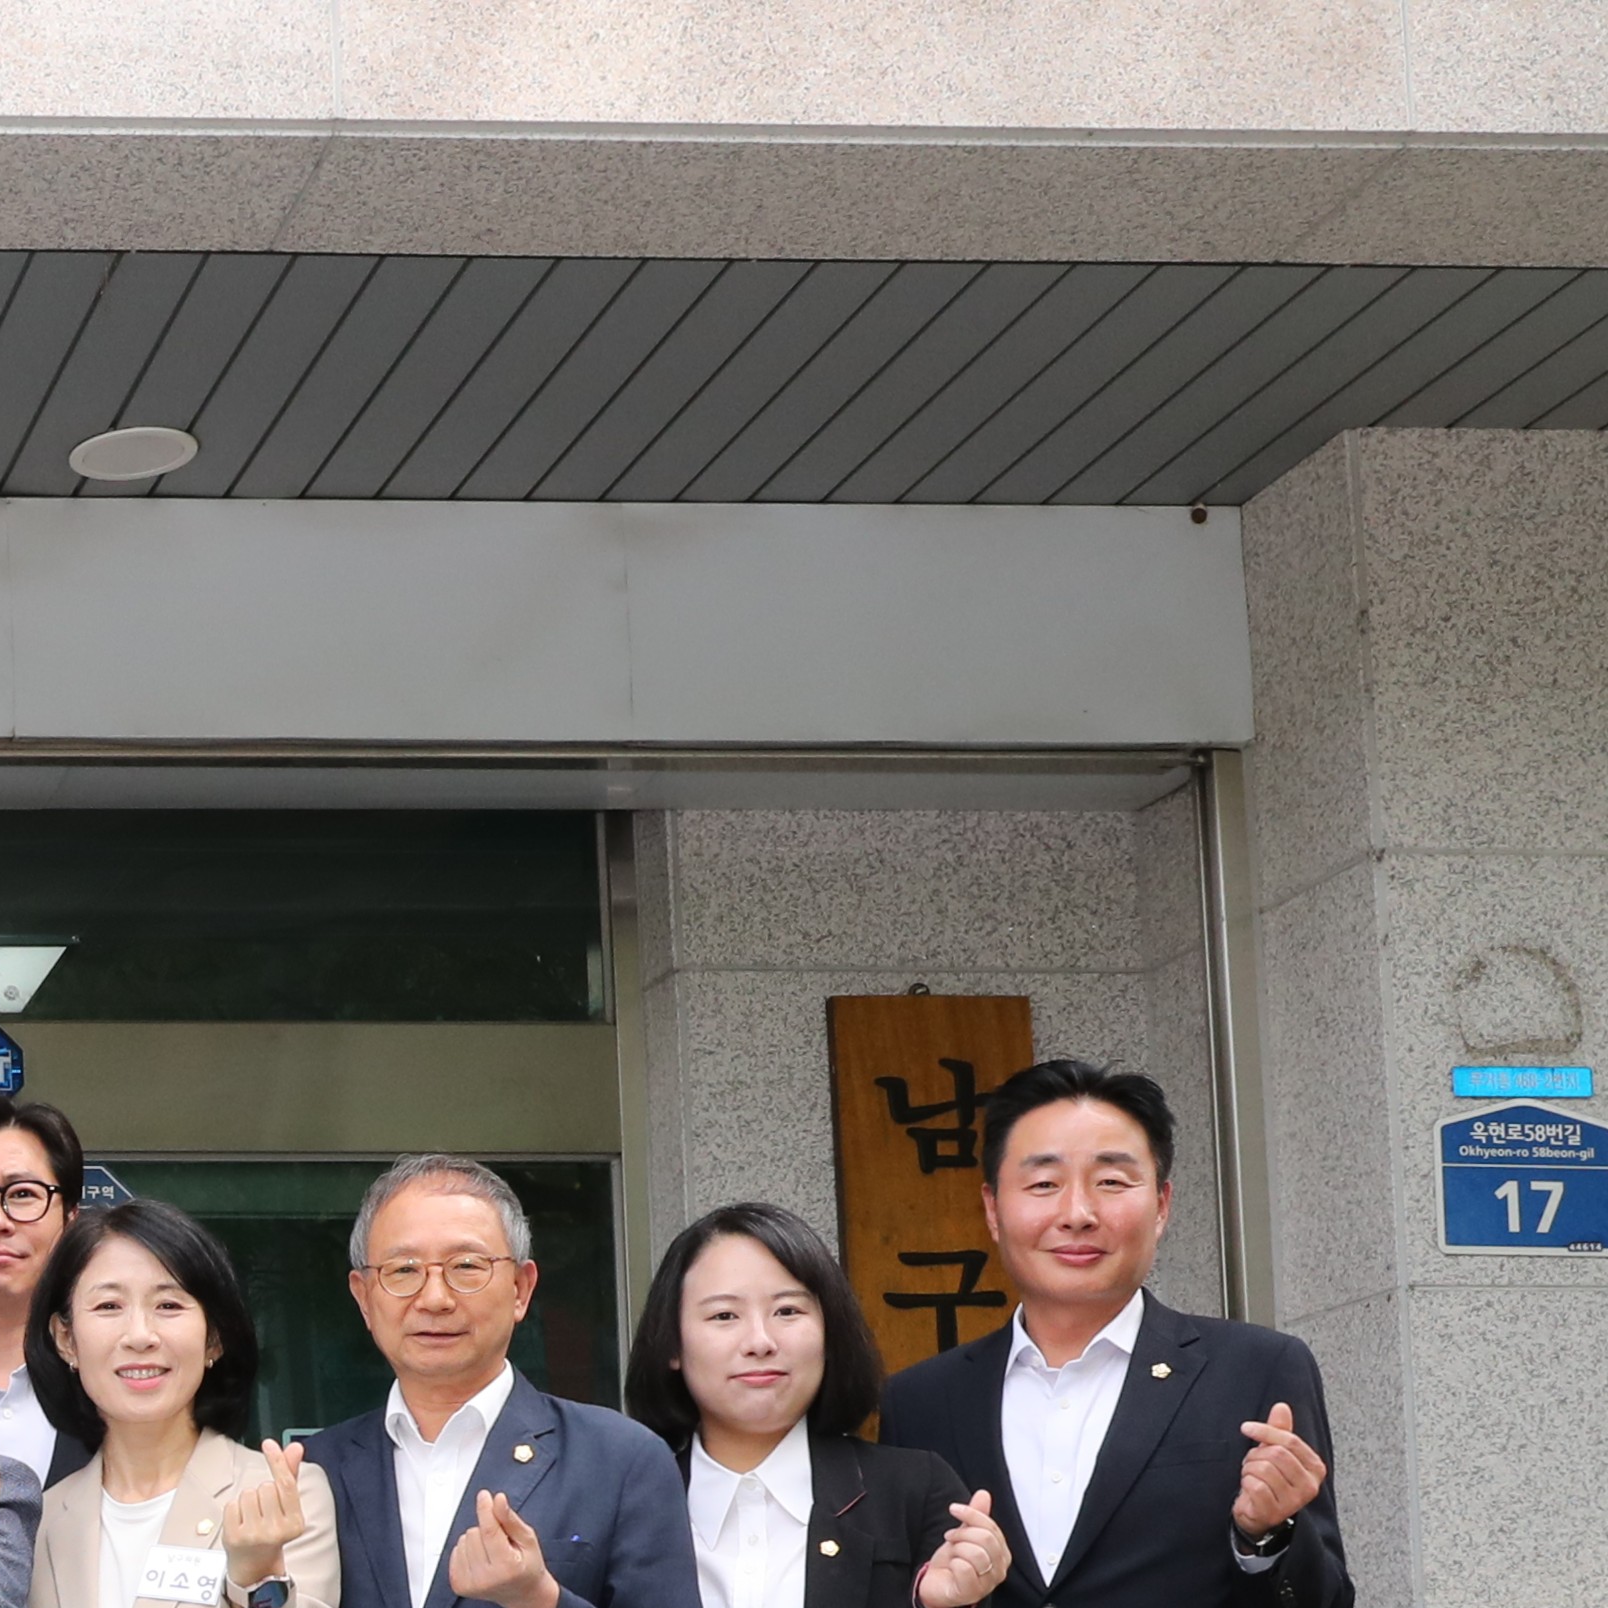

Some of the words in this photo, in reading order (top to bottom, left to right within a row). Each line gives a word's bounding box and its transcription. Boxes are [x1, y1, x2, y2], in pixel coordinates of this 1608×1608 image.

[1469, 1121, 1582, 1146] 옥현로58번길
[1458, 1145, 1530, 1160] Okhyeon-ro
[1531, 1147, 1595, 1161] 58beon-gil
[1493, 1180, 1565, 1234] 17
[145, 1569, 218, 1601] 이소영
